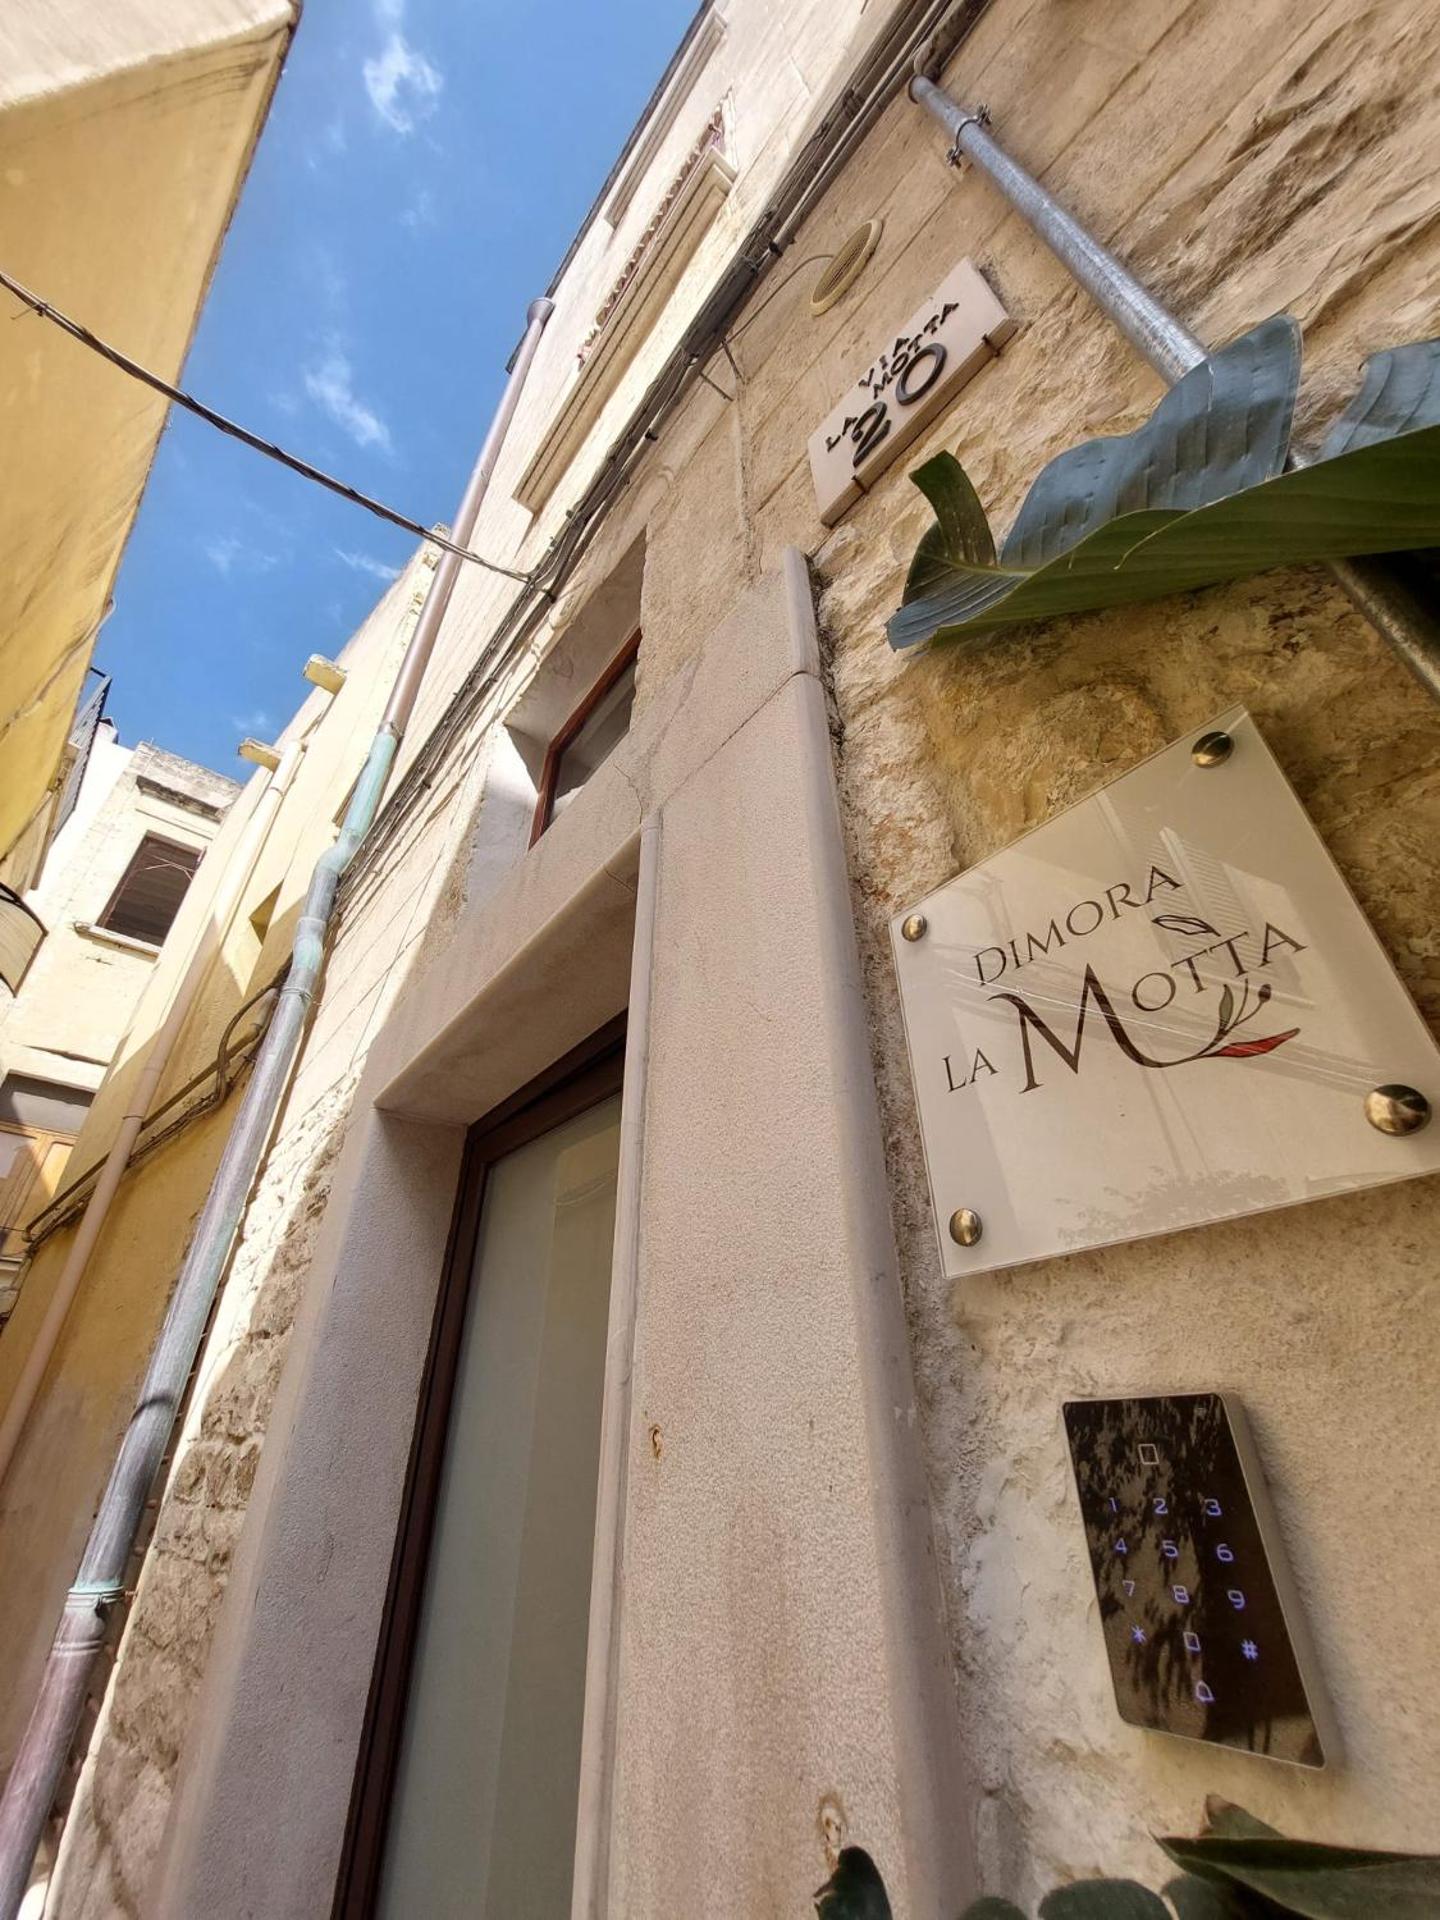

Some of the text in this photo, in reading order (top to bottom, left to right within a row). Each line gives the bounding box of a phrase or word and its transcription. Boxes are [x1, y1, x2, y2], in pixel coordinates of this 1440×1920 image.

[826, 302, 960, 453] LA MOTTA
[851, 342, 948, 468] 20
[858, 337, 910, 389] VIA
[973, 865, 1184, 987] DIMORA
[942, 921, 1307, 1095] LA MOTTA
[1108, 1497, 1222, 1516] 1 2 3
[1114, 1537, 1234, 1562] 4 5 6
[1122, 1580, 1246, 1609] 7 8 9
